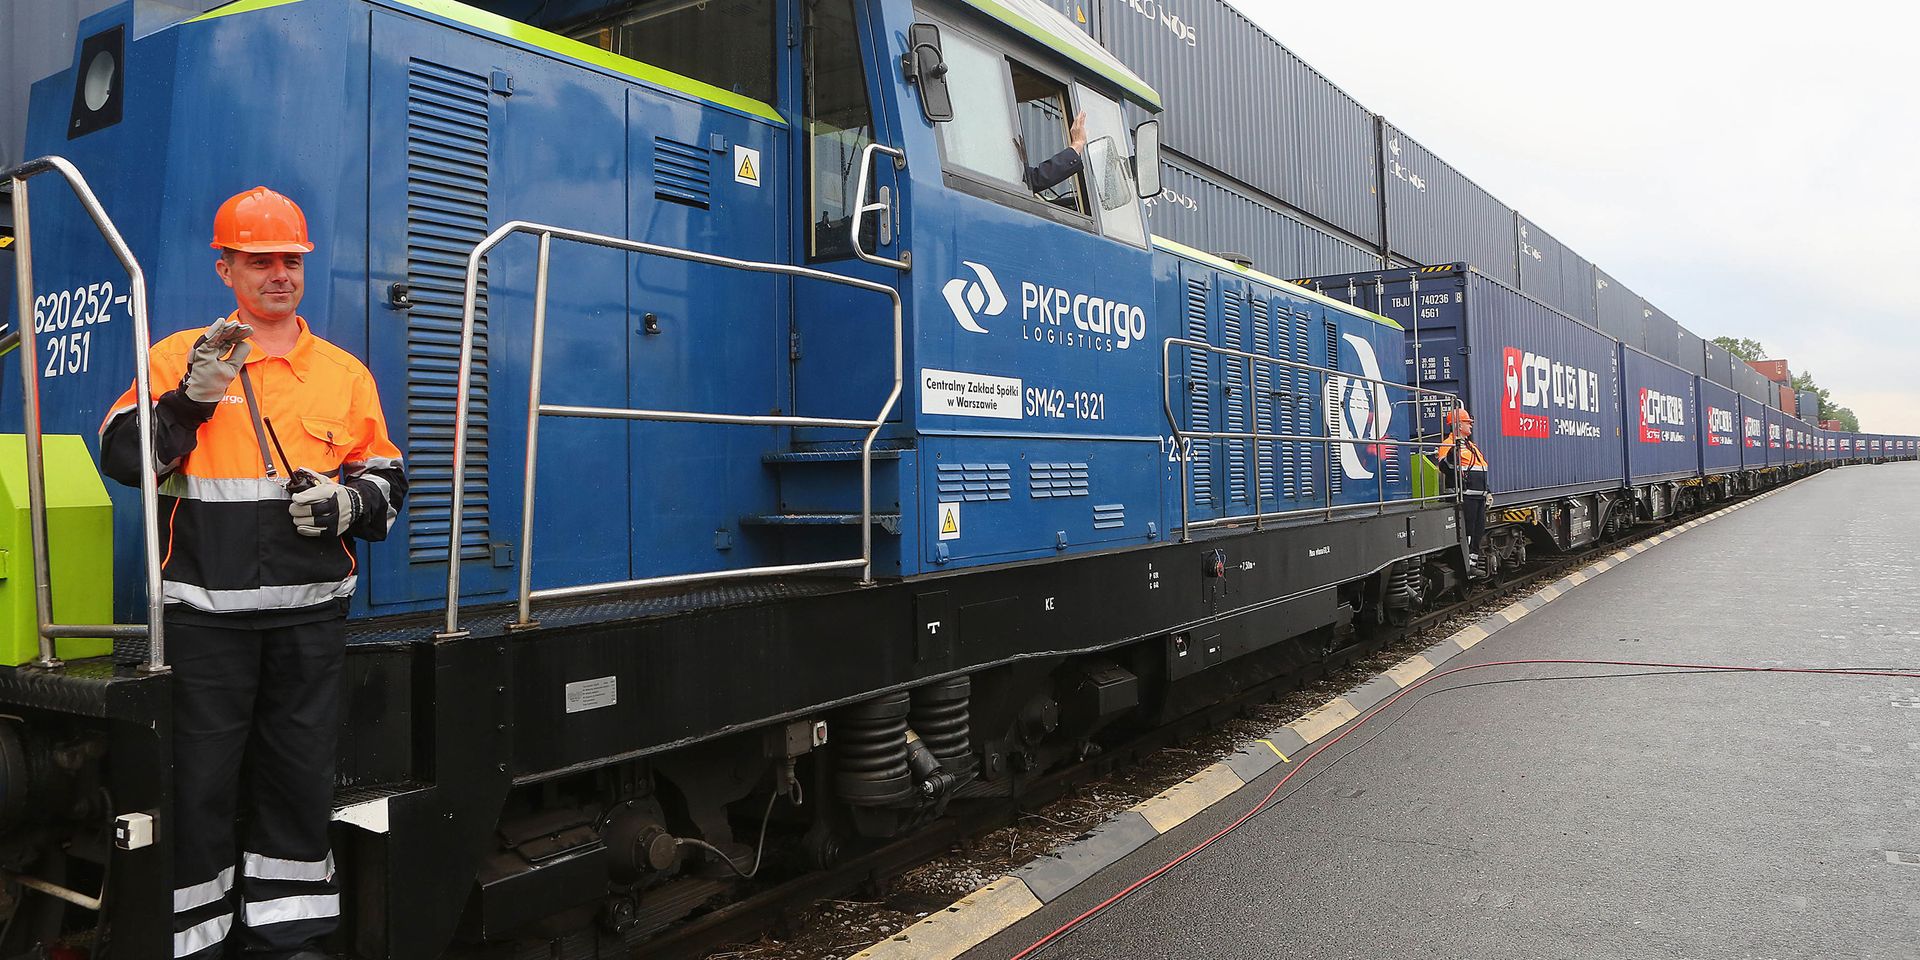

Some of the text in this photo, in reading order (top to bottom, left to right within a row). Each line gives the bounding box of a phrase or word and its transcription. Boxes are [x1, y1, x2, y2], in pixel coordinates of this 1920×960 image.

[1122, 0, 1197, 47] ONOS
[71, 281, 134, 328] 252-
[1391, 296, 1411, 308] TBJU
[1420, 293, 1449, 306] 740236
[1023, 325, 1112, 352] LOGISTICS
[44, 331, 91, 377] 2151
[926, 377, 1019, 398] Centralny Zakład Spółki
[946, 396, 998, 411] w Warszawie
[1025, 387, 1105, 421] SM42-1321
[1045, 597, 1055, 611] KE
